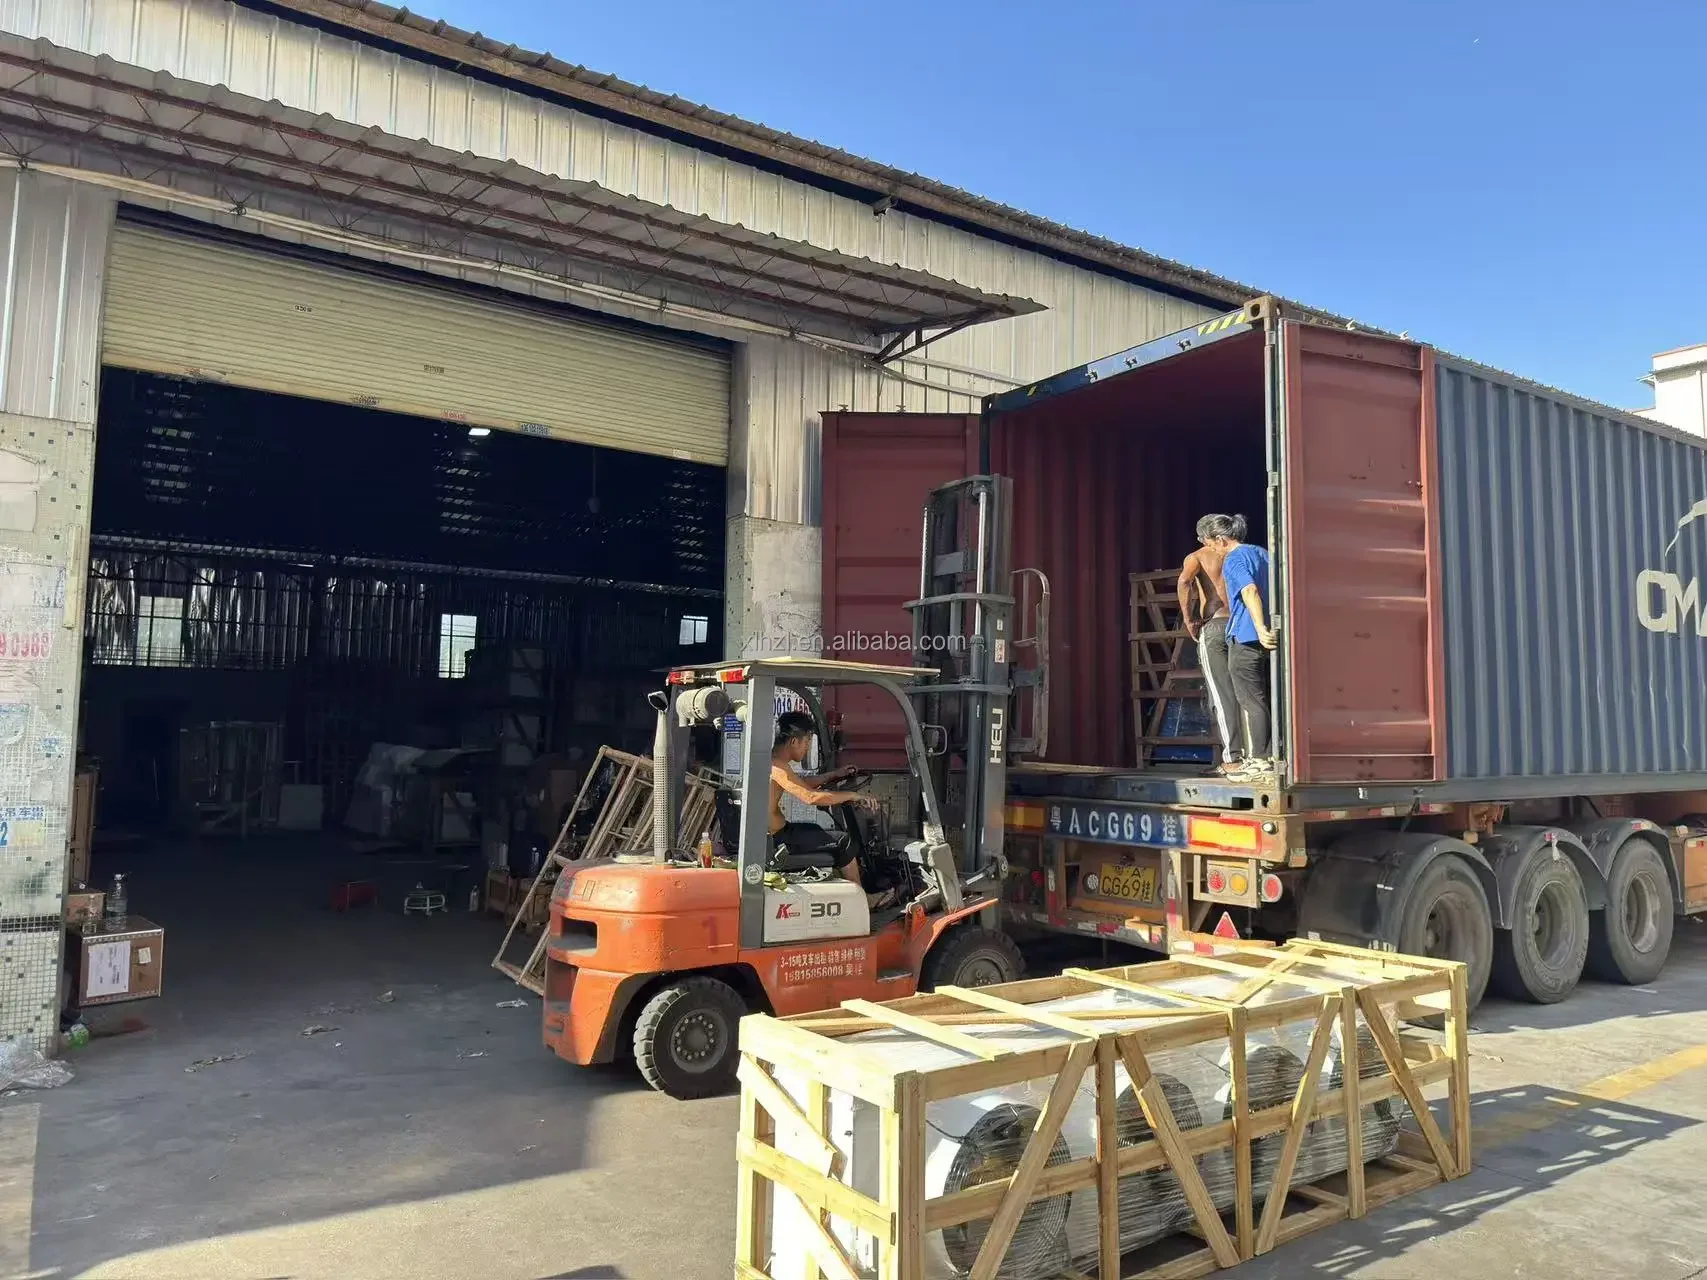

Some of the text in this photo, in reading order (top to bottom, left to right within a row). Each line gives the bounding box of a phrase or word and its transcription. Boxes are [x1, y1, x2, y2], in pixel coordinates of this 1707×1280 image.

[1636, 569, 1707, 637] CM
[990, 708, 1003, 764] HELI
[811, 902, 842, 918] 30
